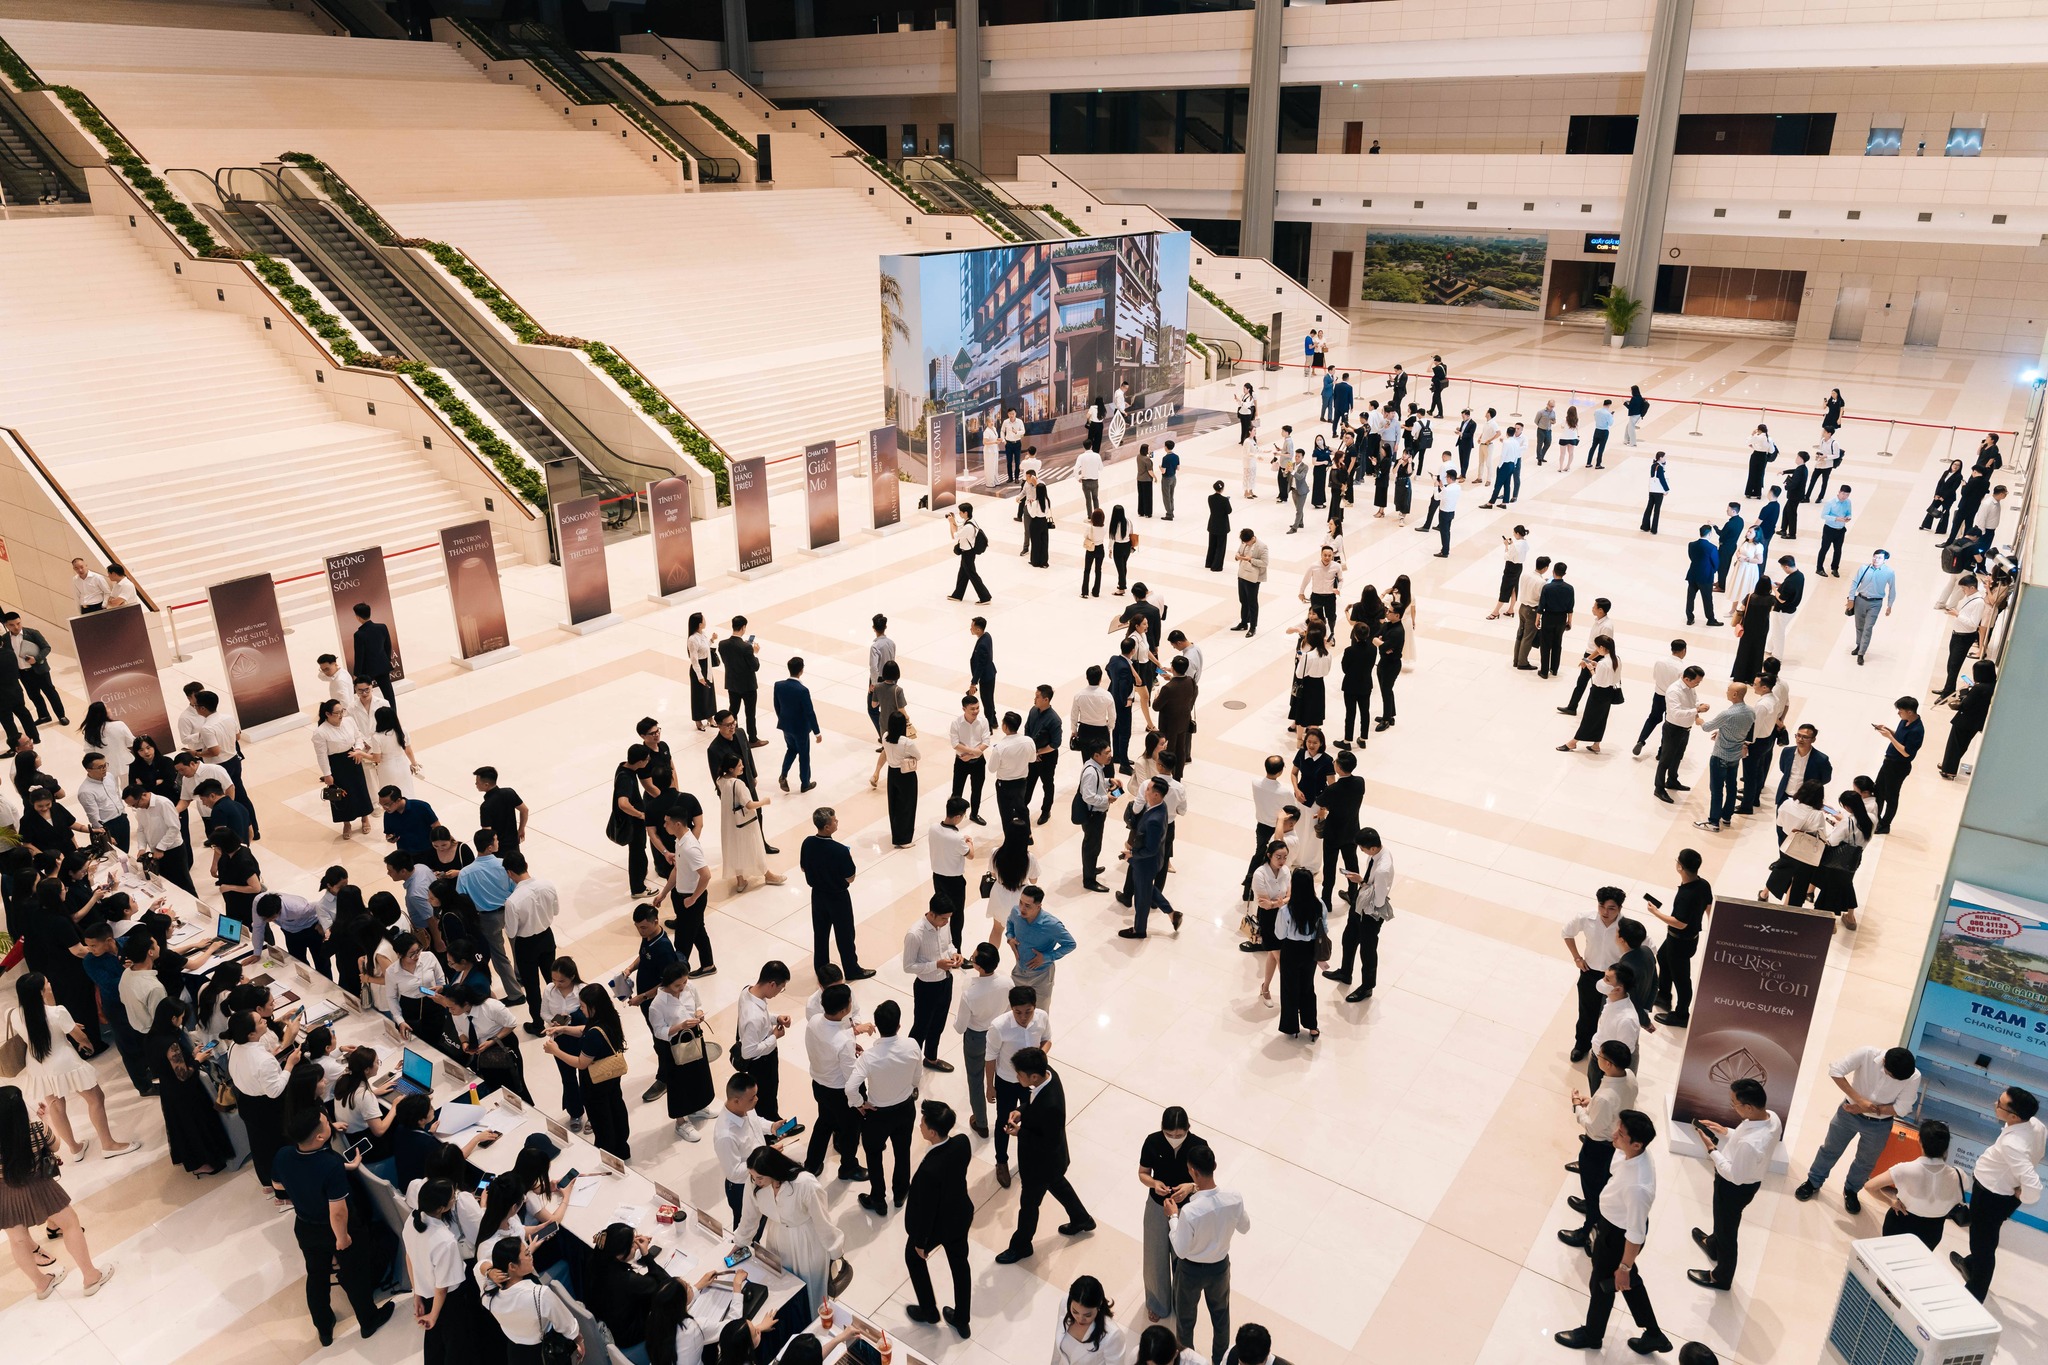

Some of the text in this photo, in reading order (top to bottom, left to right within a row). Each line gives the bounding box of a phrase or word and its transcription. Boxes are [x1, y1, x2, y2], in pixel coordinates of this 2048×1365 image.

[1130, 402, 1175, 427] ICONIA
[1136, 421, 1168, 438] LAKESIDE
[933, 420, 942, 485] WELCOME
[734, 464, 747, 473] CỦA
[808, 458, 831, 475] Giấc
[735, 471, 753, 482] HÀNG
[735, 480, 753, 490] TRIỆU
[810, 478, 827, 493] Mơ
[448, 545, 474, 557] THÀNH
[329, 554, 366, 570] KHÔNG
[331, 567, 350, 580] CHỈ
[333, 578, 361, 592] SỐNG
[225, 629, 270, 646] Sống sang
[252, 640, 267, 648] ven
[100, 684, 151, 704] Giữa lòng
[1771, 928, 1798, 936] ESTATE
[1967, 926, 2011, 936] 0818.441133
[1970, 920, 2008, 929] 080.41133
[1716, 940, 1818, 960] ICONIA LAKESIDE INSPIRATIONAL EVENT
[1714, 950, 1782, 972] the Rise
[1760, 970, 1772, 978] of
[1988, 980, 2011, 992] NCC
[2012, 986, 2047, 1003] GADEN
[1714, 996, 1794, 1016] KHU VỰC SỰ KIỆN
[1971, 1001, 2027, 1029] TRẠM
[2034, 1021, 2048, 1036] S
[1964, 1017, 2048, 1048] CHARGING STA
